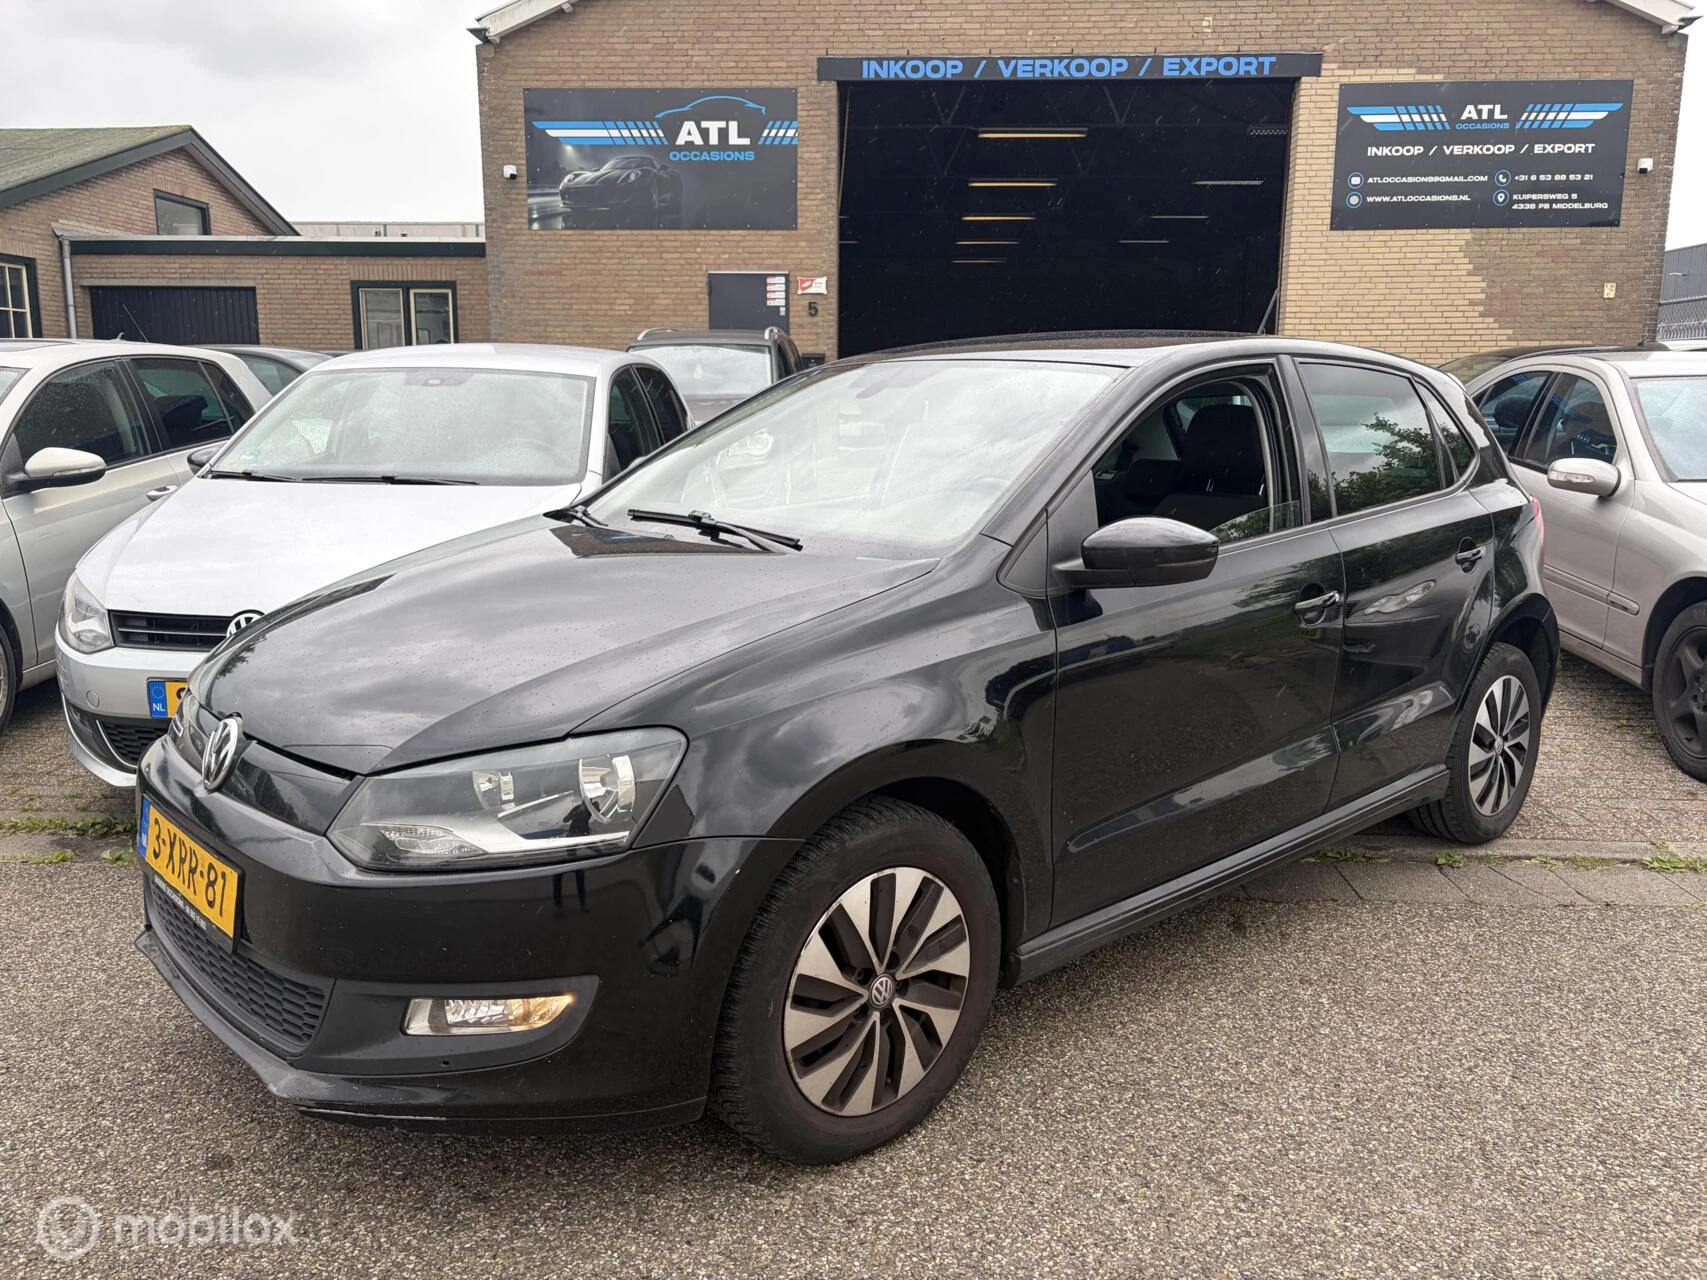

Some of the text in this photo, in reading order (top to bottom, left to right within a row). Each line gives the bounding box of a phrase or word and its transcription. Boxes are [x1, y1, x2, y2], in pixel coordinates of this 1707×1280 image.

[862, 56, 1277, 79] INKOOP / VERKOOP / EXPORT
[1460, 104, 1508, 120] ATL
[1456, 122, 1511, 130] OCCASIONS
[675, 120, 751, 145] ATL
[1367, 143, 1596, 156] INKOOP / VERKOOP / EXPORT
[669, 151, 755, 161] OCCASIONS
[1367, 175, 1489, 184] ATLOCCASIONS@GMAIL.COM
[1366, 194, 1471, 203] WWW.ATLOCCASIONS.NL
[1552, 202, 1609, 210] MIDDELBURG
[807, 301, 819, 318] 5
[152, 702, 166, 712] NL
[152, 817, 228, 918] 3-XRR-81
